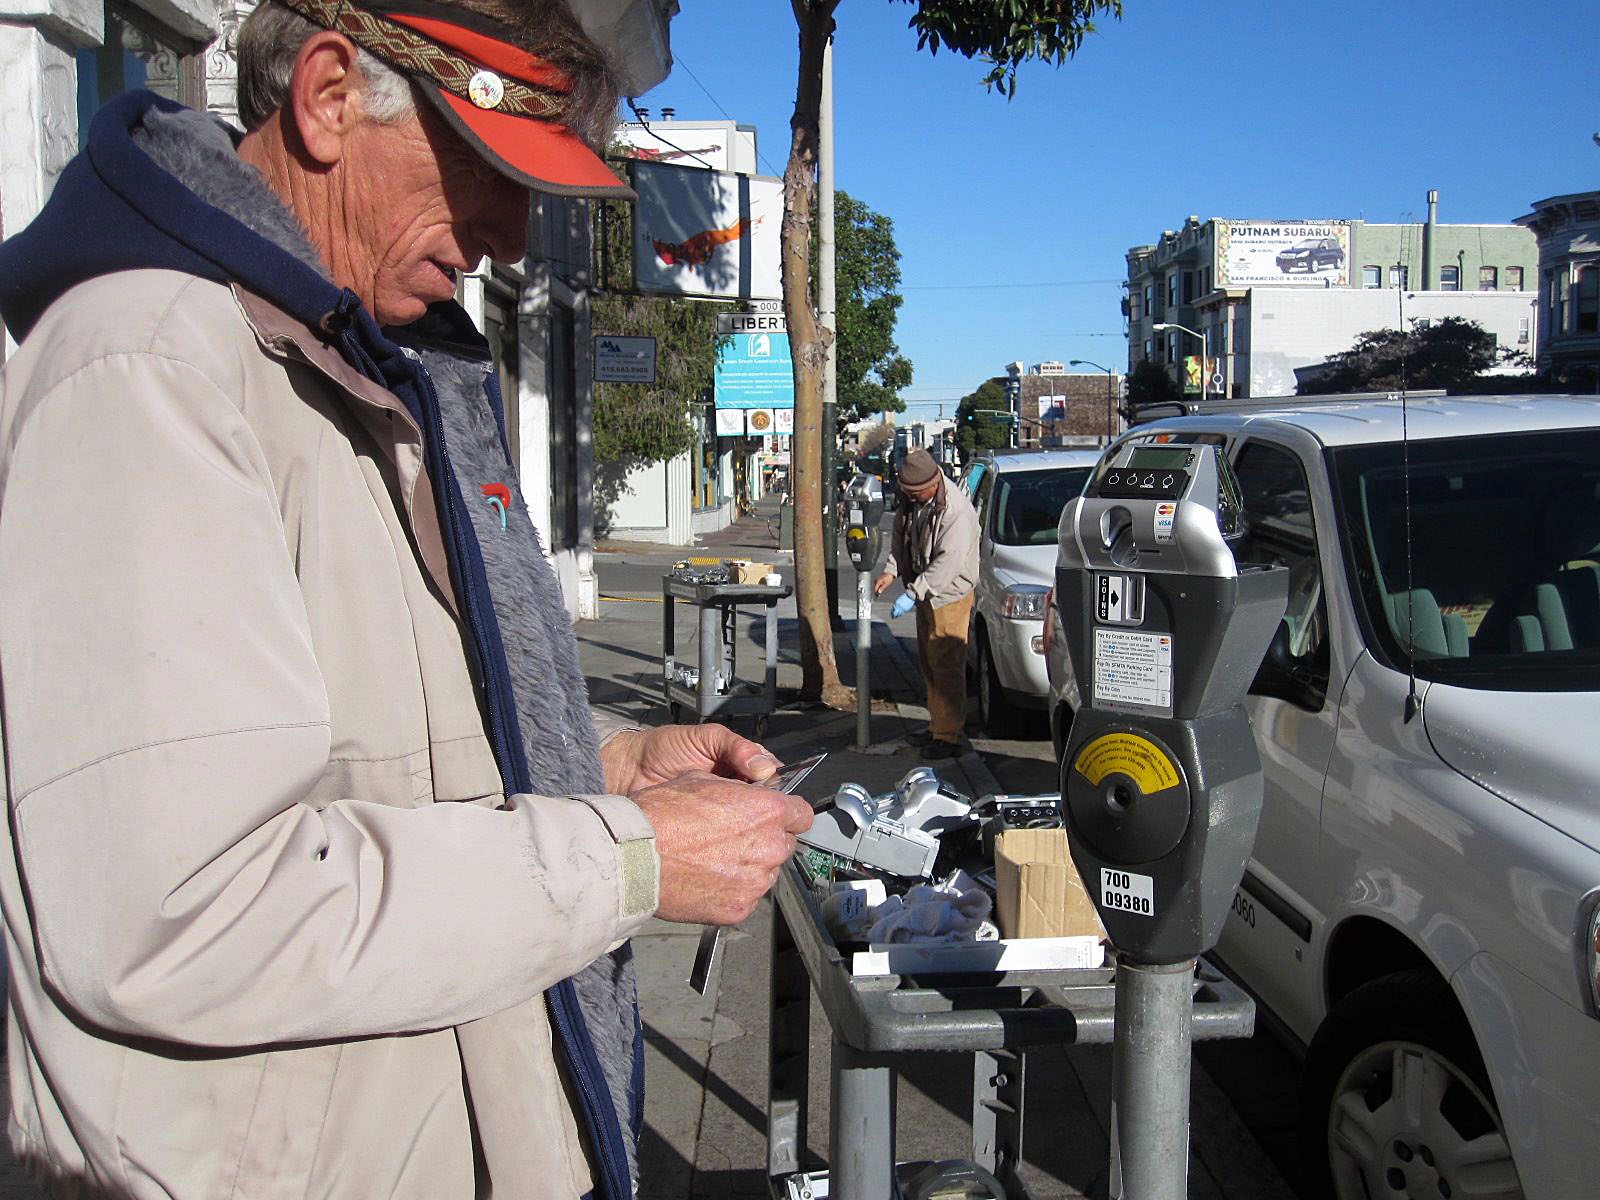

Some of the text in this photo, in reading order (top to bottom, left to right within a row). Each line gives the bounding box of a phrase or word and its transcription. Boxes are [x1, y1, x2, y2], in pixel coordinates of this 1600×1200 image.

[1231, 228, 1331, 236] PUTNAM SUBARU
[732, 318, 786, 329] LIBERT
[1105, 871, 1130, 889] 700
[1106, 891, 1150, 913] 09380
